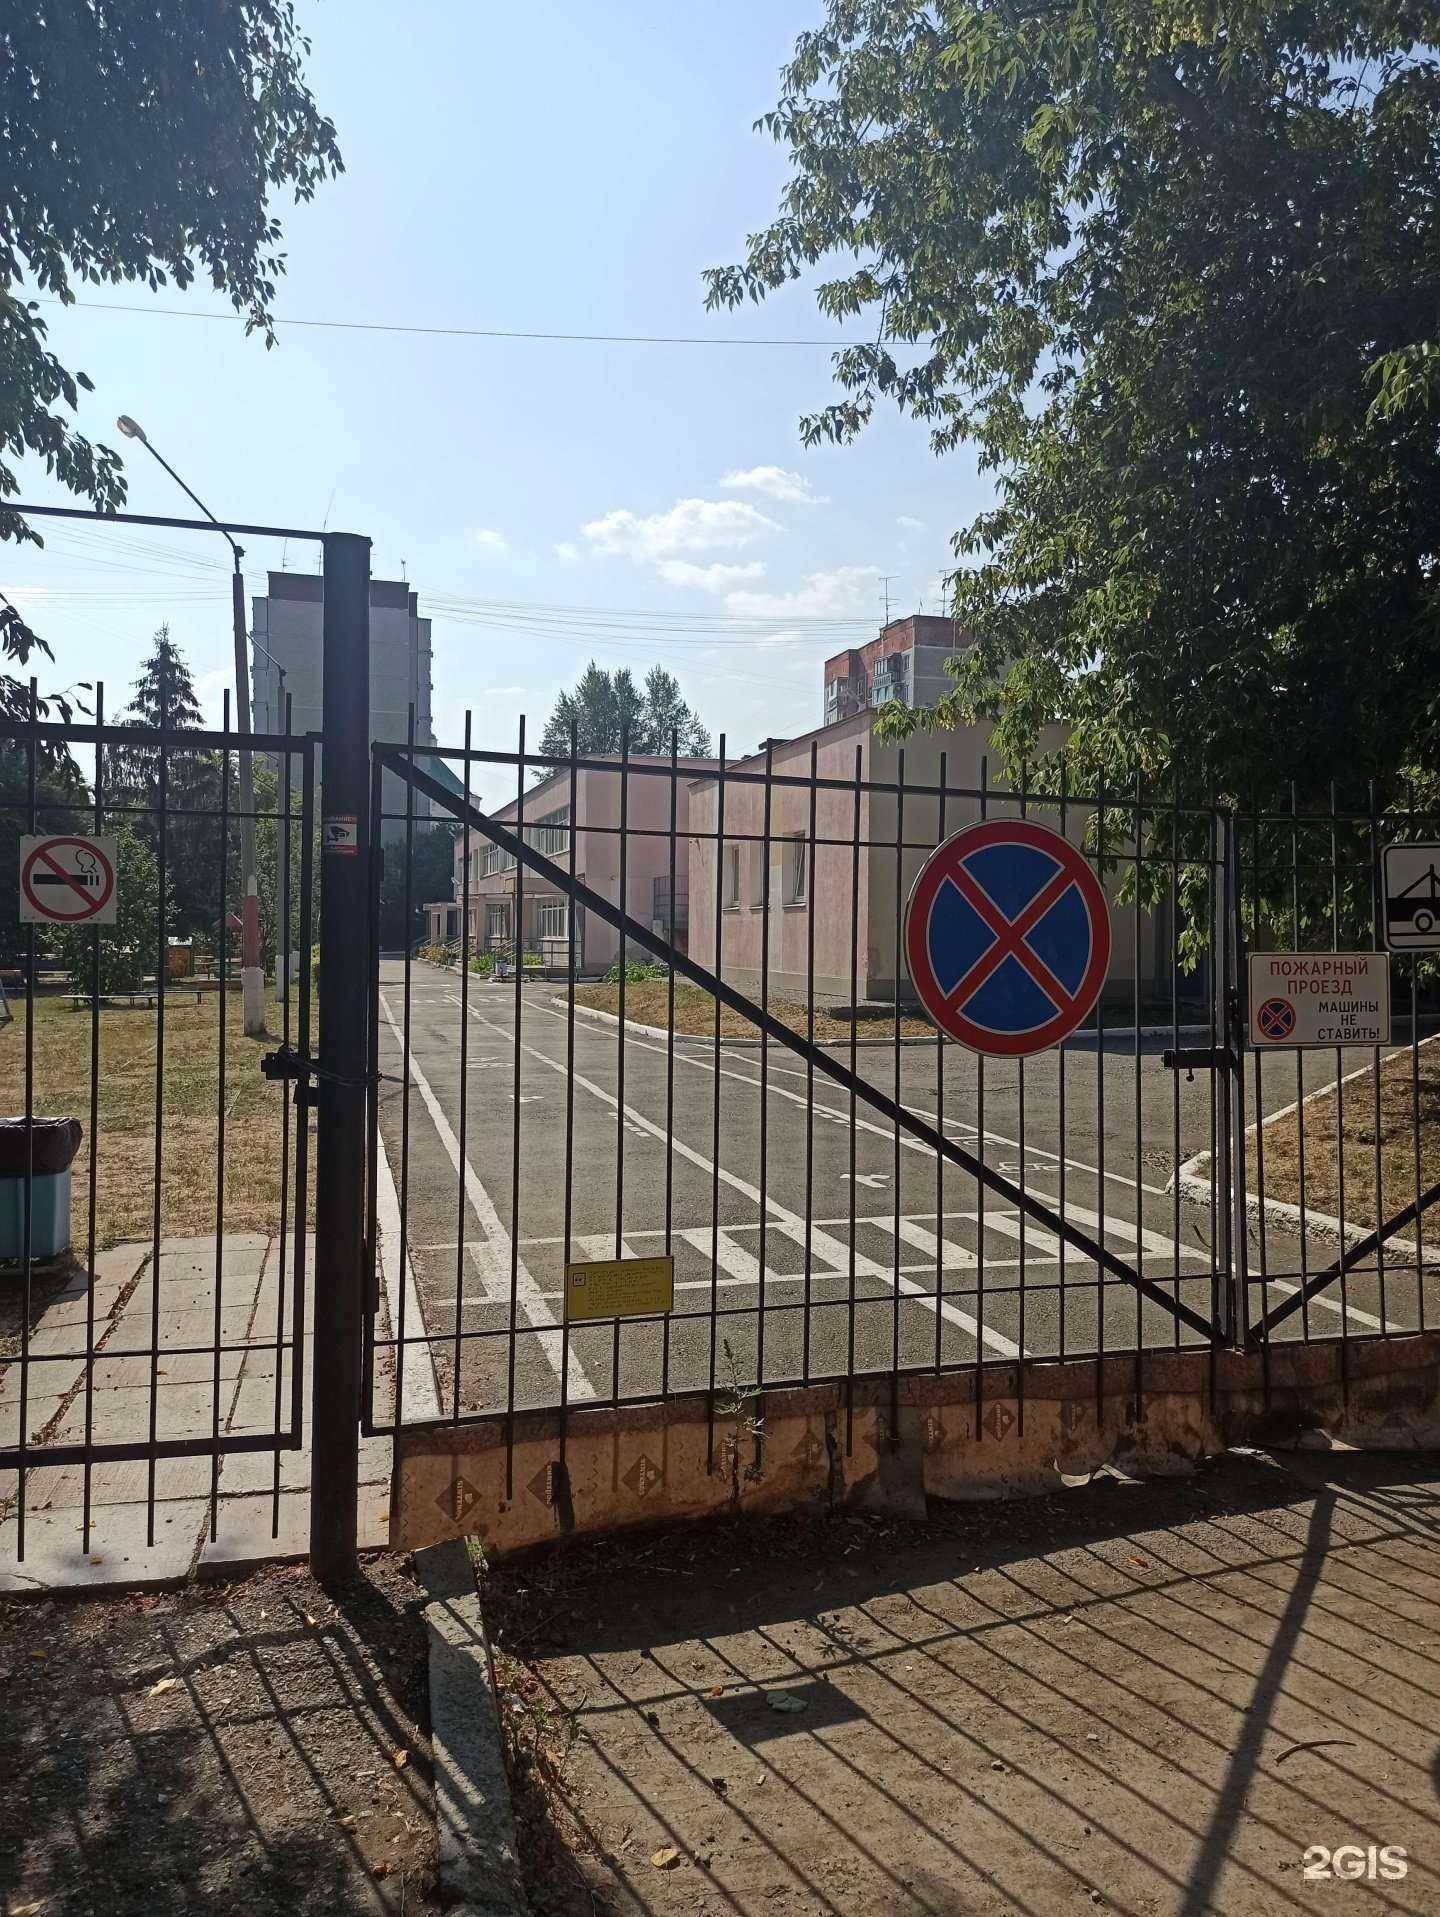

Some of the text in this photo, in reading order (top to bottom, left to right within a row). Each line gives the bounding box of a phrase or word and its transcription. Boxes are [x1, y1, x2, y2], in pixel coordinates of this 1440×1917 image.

[1270, 957, 1369, 976] ПОЖАРНЫЙ
[1287, 980, 1353, 996] ПРОЕЗД
[1318, 1001, 1379, 1013] МАШИНЫ
[1340, 1015, 1357, 1026] НЕ
[1318, 1028, 1380, 1040] СТАВИТЬ!
